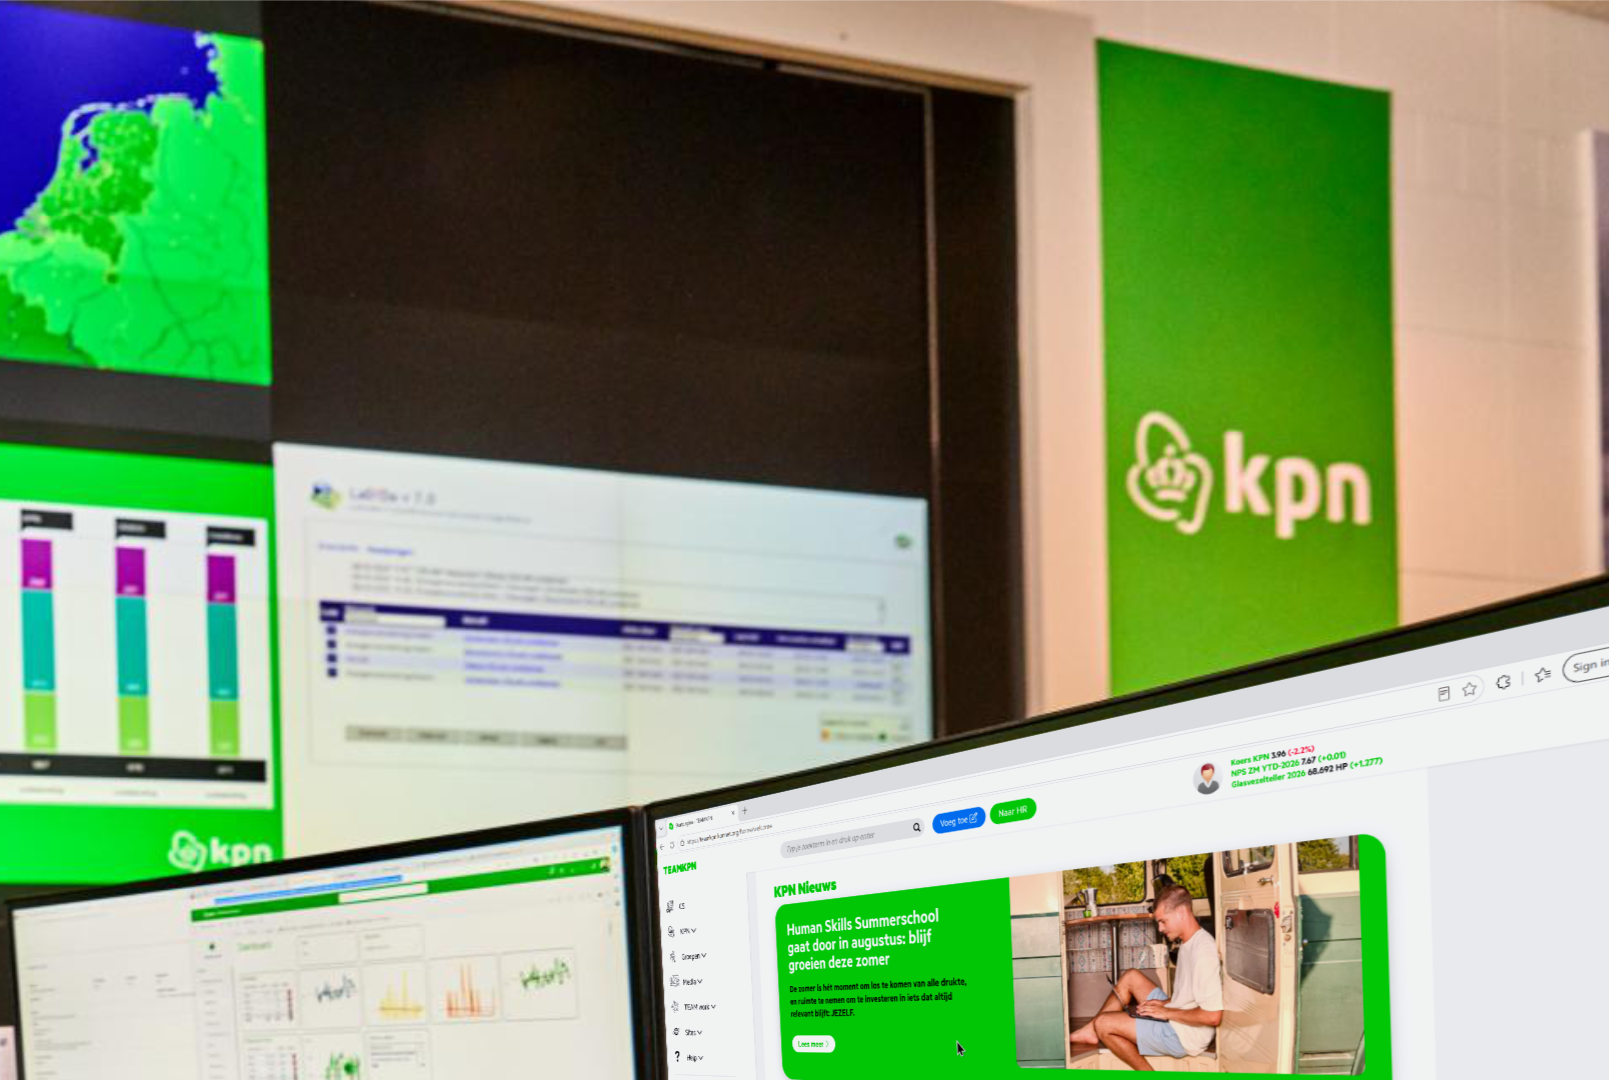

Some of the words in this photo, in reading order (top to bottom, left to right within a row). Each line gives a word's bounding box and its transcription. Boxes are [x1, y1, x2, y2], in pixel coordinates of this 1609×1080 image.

[1224, 430, 1372, 539] kpn
[1573, 661, 1598, 674] Sign
[1230, 756, 1252, 766] Koers
[1253, 753, 1270, 763] KPN
[1287, 745, 1315, 757] (-2.2%)
[1231, 768, 1247, 777] NPS
[1248, 765, 1260, 775] ZM
[1261, 759, 1300, 772] YTD-2026
[1231, 773, 1286, 788] Glasvezelteller
[1286, 770, 1306, 780] 2026
[1335, 762, 1348, 772] HP
[998, 808, 1015, 818] Naar
[1016, 805, 1028, 814] HR
[940, 818, 956, 828] Voeg
[957, 816, 968, 825] toe
[210, 836, 273, 868] kpn
[663, 861, 697, 875] TEAMKPN
[773, 884, 796, 898] KPN
[798, 880, 837, 895] Nieuws
[786, 923, 822, 936] Human
[824, 917, 852, 932] Skills
[855, 907, 939, 930] Summerschool
[787, 940, 810, 957] gaat
[812, 938, 836, 952] door
[838, 936, 849, 949] in
[851, 933, 906, 951] augustus:
[908, 928, 932, 947] blijf
[788, 957, 826, 974] groeien
[828, 955, 853, 969] deze
[855, 955, 890, 967] zomer
[789, 985, 798, 993] De
[816, 983, 822, 992] is
[833, 983, 859, 991] moment
[871, 981, 880, 989] los
[881, 981, 889, 989] te
[889, 980, 912, 989] komen
[913, 979, 926, 988] van
[926, 978, 939, 987] alle
[940, 977, 967, 987] drukte,
[797, 997, 817, 1005] ruimte
[864, 994, 898, 1003] investeren
[899, 993, 906, 1002] in
[906, 993, 920, 1002] iets
[920, 992, 933, 1001] dat
[934, 991, 953, 1002] altijd
[790, 1009, 814, 1017] relevant
[831, 1008, 855, 1017] JEZELF.
[797, 1040, 810, 1048] Lees
